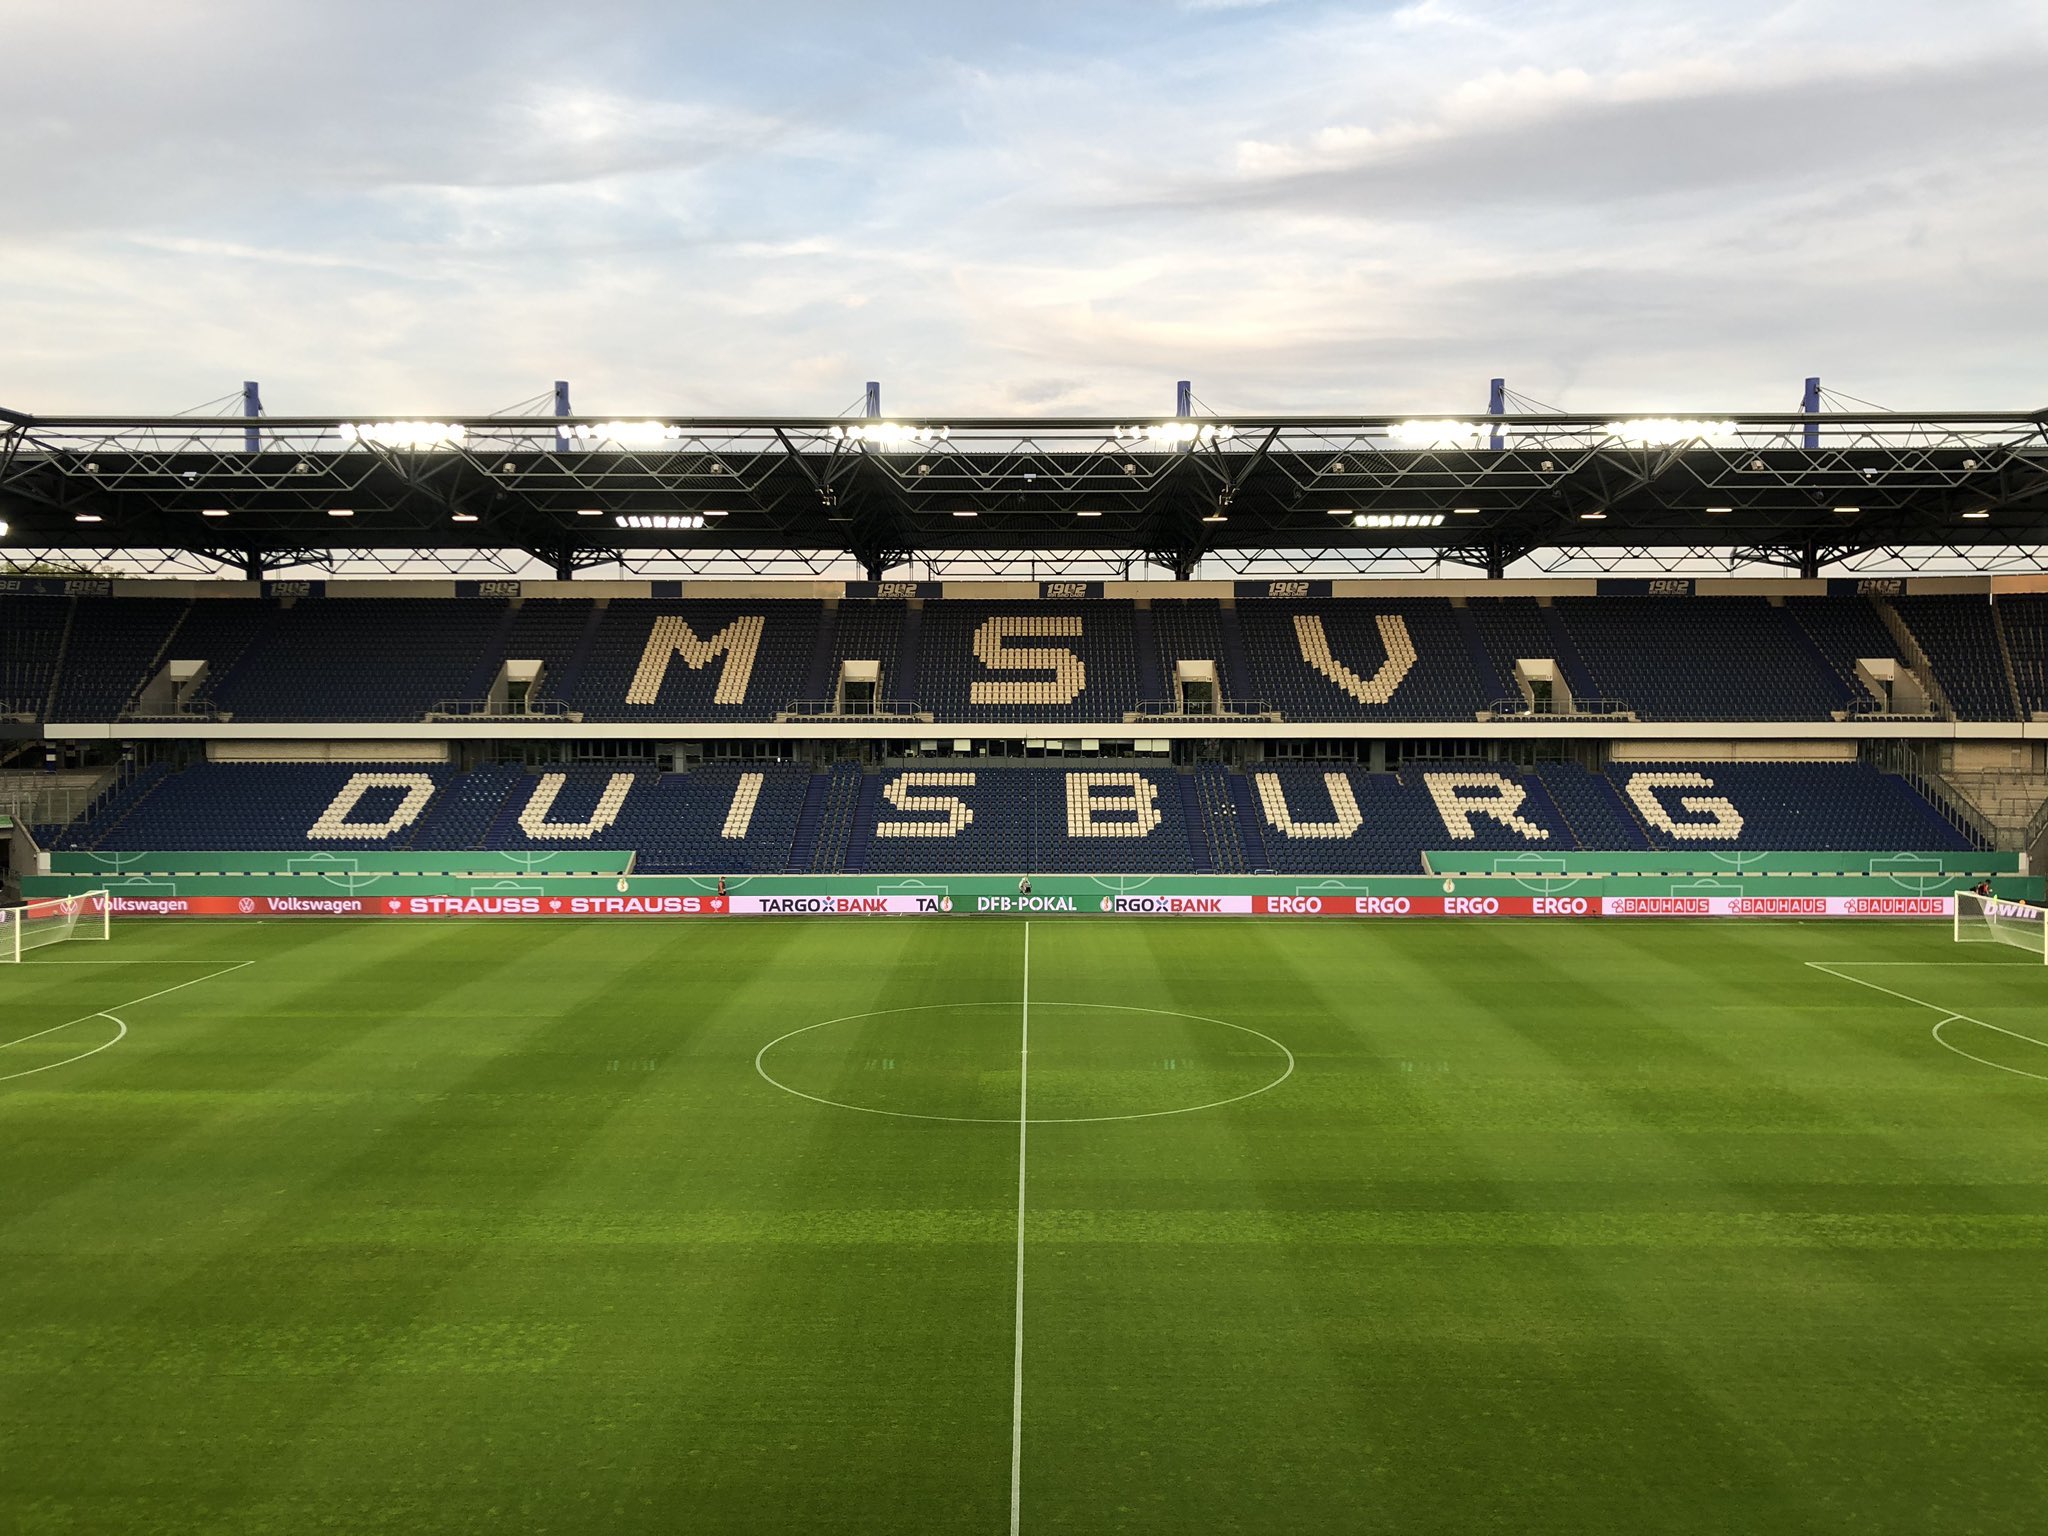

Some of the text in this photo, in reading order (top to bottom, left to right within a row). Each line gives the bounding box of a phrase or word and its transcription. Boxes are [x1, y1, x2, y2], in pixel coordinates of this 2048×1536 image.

[270, 582, 311, 593] 1902
[479, 582, 519, 593] 1902
[877, 583, 917, 594] 1902
[1047, 583, 1087, 594] 1902
[1269, 582, 1309, 593] 1902
[1649, 580, 1689, 591] 1902
[92, 897, 188, 913] Volkswagen
[267, 897, 362, 912] Volkswagen
[410, 897, 540, 914] STRAUSS
[571, 897, 701, 914] STRAUSS
[977, 896, 1077, 912] DFB-POKAL
[1267, 896, 1322, 913] ERGO
[1355, 896, 1411, 914] ERGO
[1443, 896, 1499, 914] ERGO
[1532, 897, 1588, 914] ERGO
[1624, 898, 1710, 913] BAUHAUS
[1741, 898, 1826, 913] BAUHAUS
[1857, 898, 1944, 913] BAUHAUS
[1984, 899, 2038, 919] bwin
